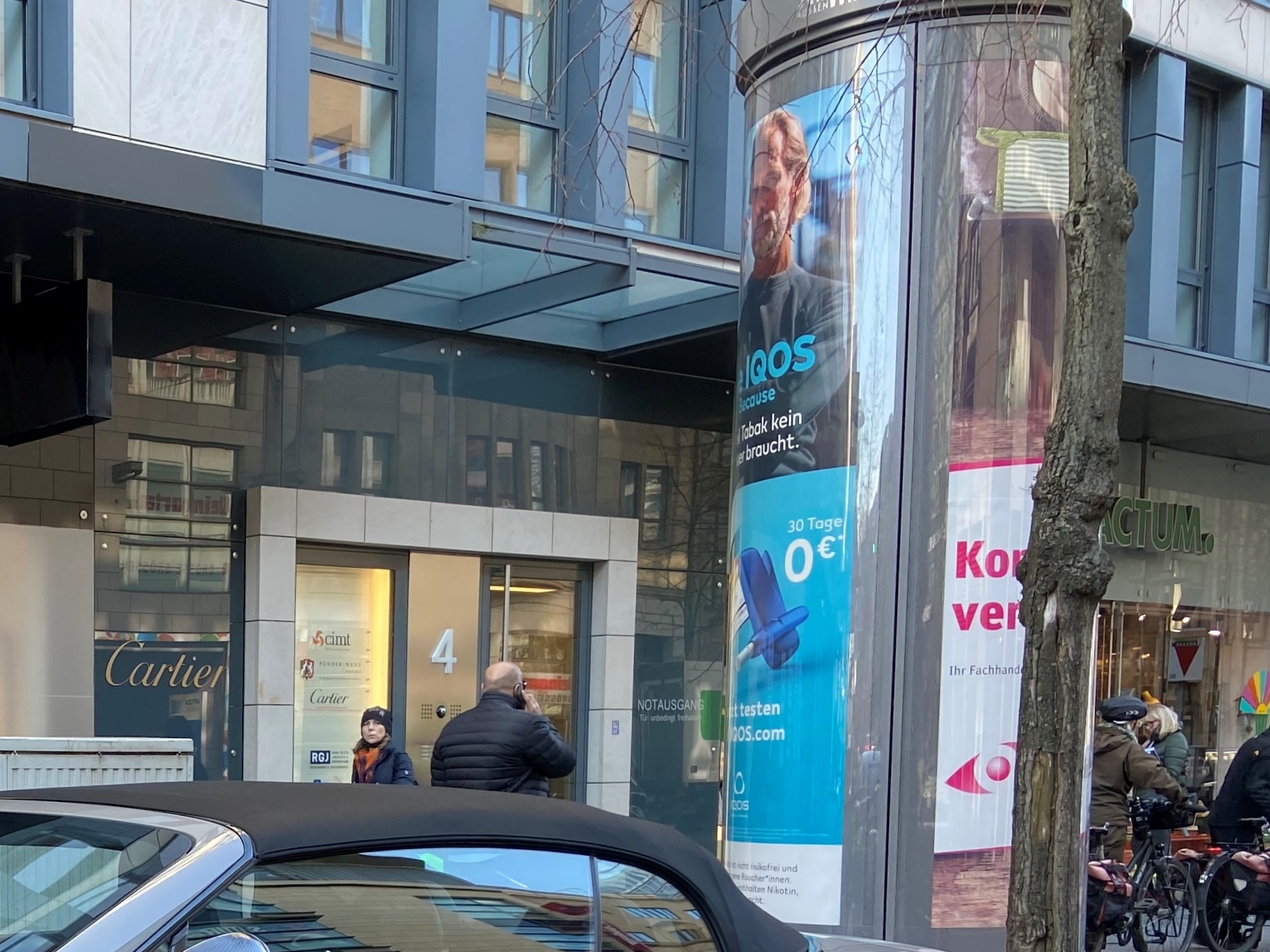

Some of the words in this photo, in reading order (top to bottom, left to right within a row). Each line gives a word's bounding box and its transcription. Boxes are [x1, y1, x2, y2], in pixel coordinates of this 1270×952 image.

[745, 334, 816, 389] IQOS
[741, 417, 768, 441] Tabak
[771, 409, 802, 432] kein
[746, 433, 799, 461] braucht.
[788, 519, 804, 533] 30
[807, 517, 843, 532] Tage
[1101, 496, 1215, 554] ACTUM.
[324, 631, 351, 646] cimt
[430, 629, 457, 674] 4
[105, 640, 229, 689] Cartier
[949, 665, 966, 675] Ihr
[970, 665, 1024, 675] Fachhand
[310, 688, 349, 704] Cartier
[637, 699, 704, 711] NOTAUSGANG
[740, 701, 780, 717] testen
[311, 752, 329, 762] RGJ
[750, 862, 780, 872] risikofrei
[782, 864, 798, 873] und
[767, 886, 799, 896] Nikotin,
